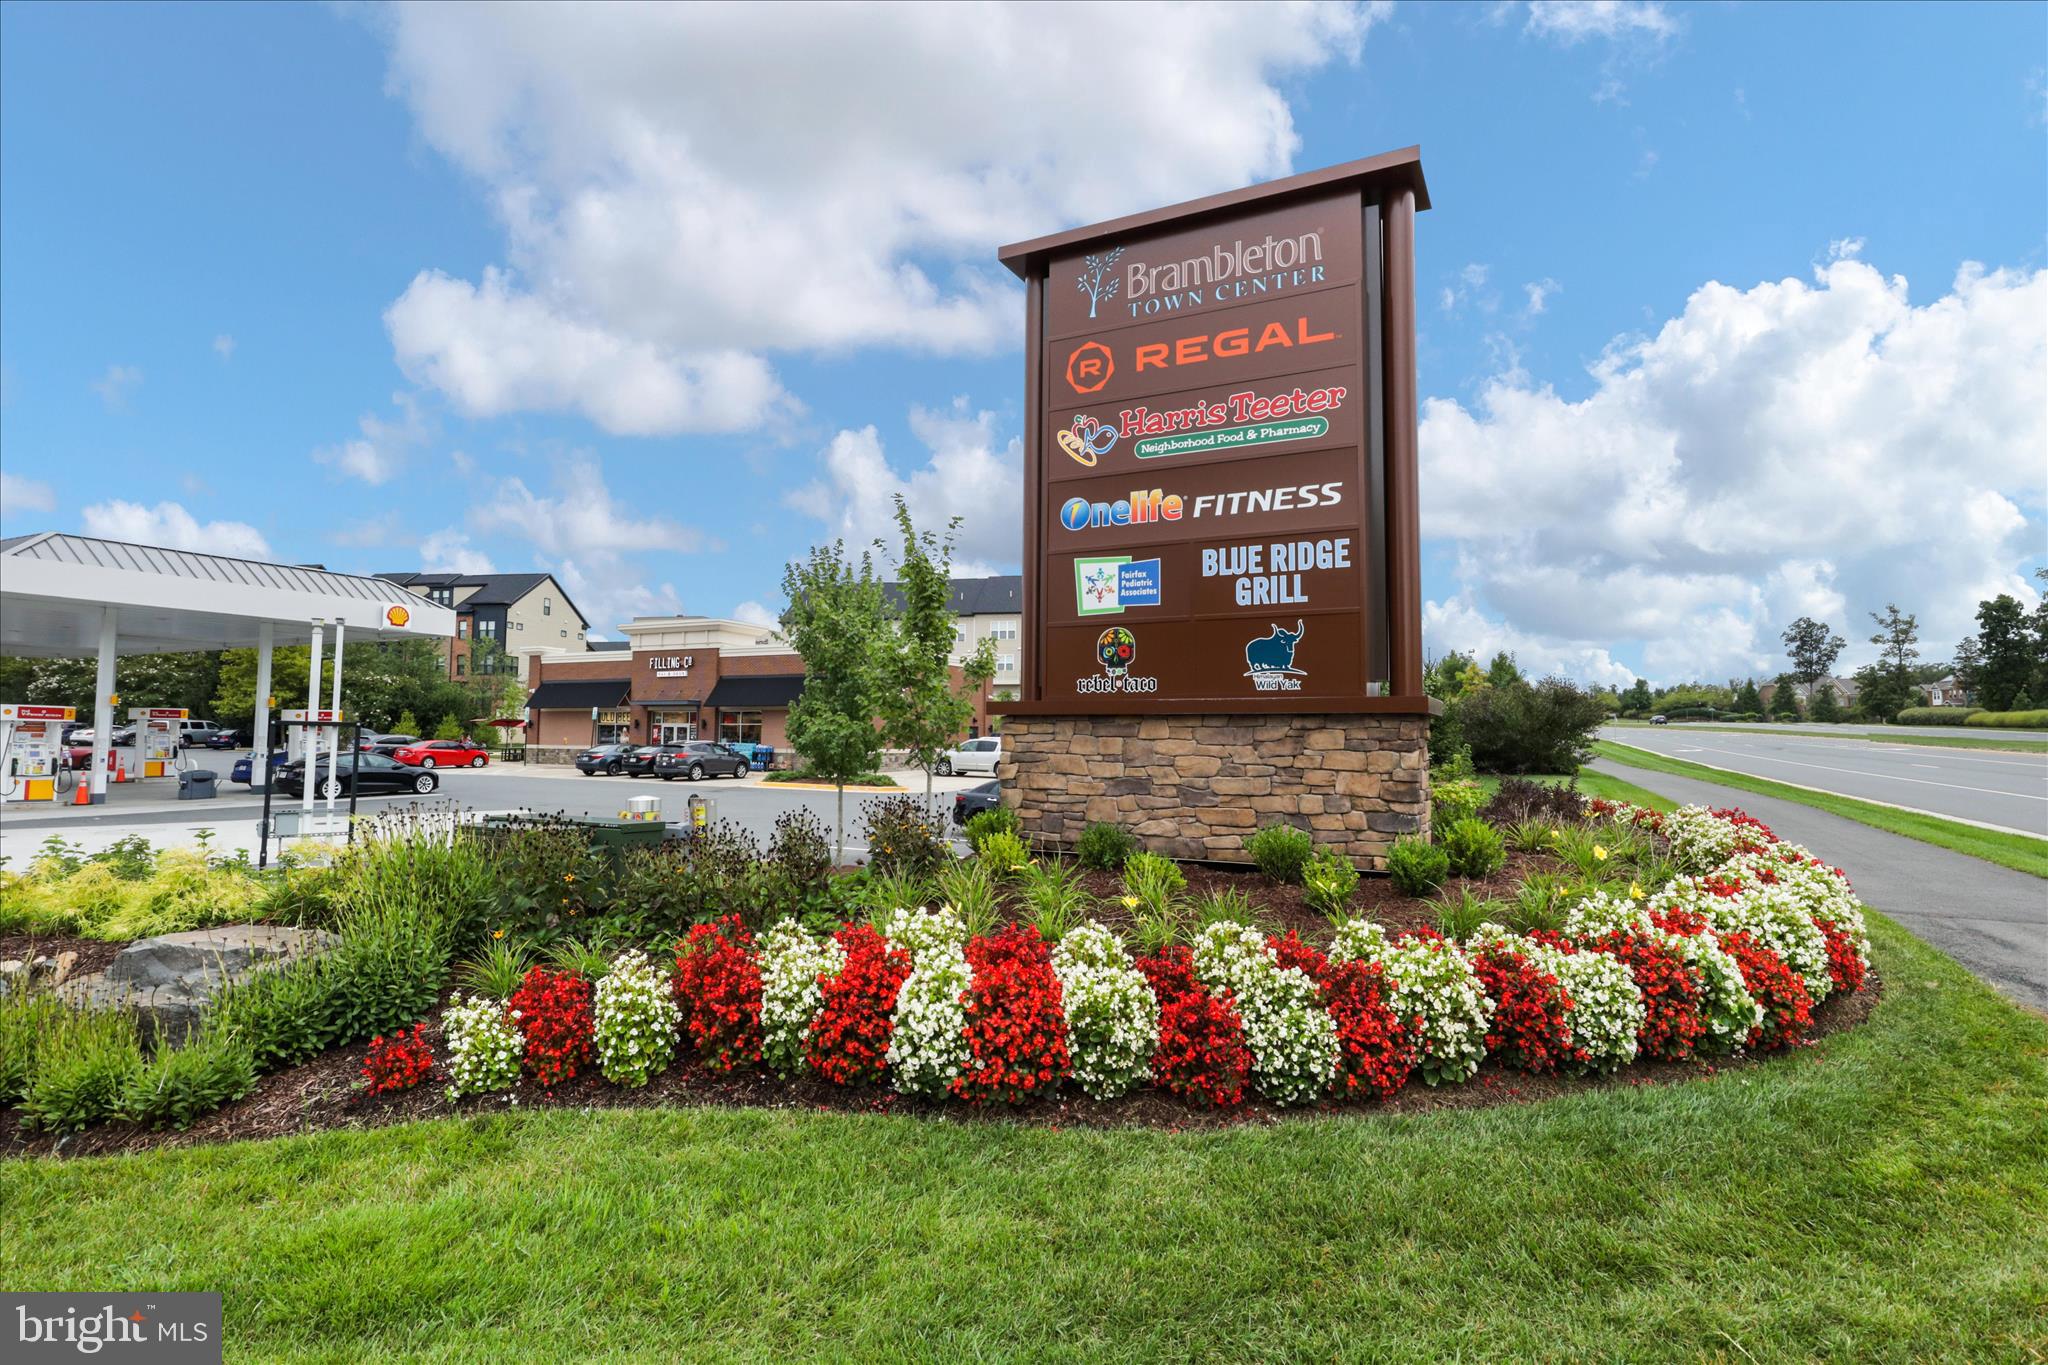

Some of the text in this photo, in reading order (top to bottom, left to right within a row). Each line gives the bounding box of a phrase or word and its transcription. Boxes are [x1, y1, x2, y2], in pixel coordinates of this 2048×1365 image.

[1127, 232, 1323, 299] Brambleton
[1127, 265, 1326, 318] TOWN CENTER
[1135, 317, 1335, 372] REGAL
[1119, 387, 1347, 438] Harris Teeter
[1141, 422, 1321, 454] Neighborhood Food & Pharmacy
[1060, 482, 1343, 531] Onelife FITNESS
[1202, 538, 1351, 577] BLUE RIDGE
[1121, 571, 1147, 579] Fairfax
[1235, 574, 1308, 606] GRILL
[1120, 588, 1157, 596] Associates
[649, 657, 680, 669] FILLING
[1077, 674, 1158, 693] rebel taco
[1255, 679, 1301, 690] Wild Yak
